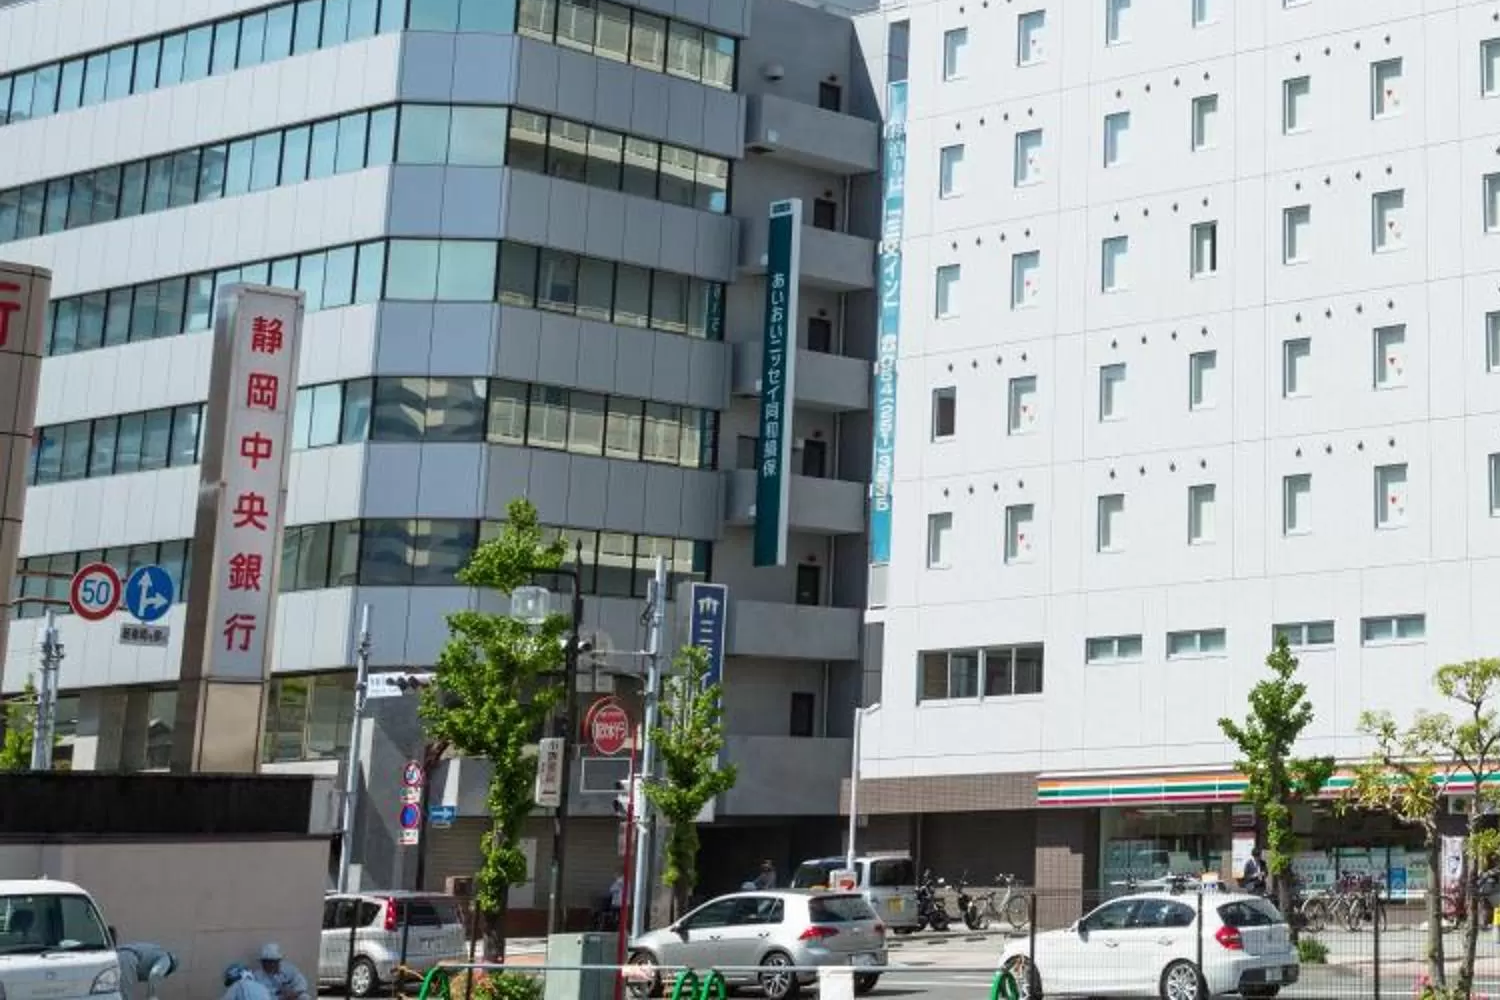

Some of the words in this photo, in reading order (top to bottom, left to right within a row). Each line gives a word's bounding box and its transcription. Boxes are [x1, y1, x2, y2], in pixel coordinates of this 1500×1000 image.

[223, 316, 283, 652] 静岡中央銀行
[82, 578, 111, 605] 50
